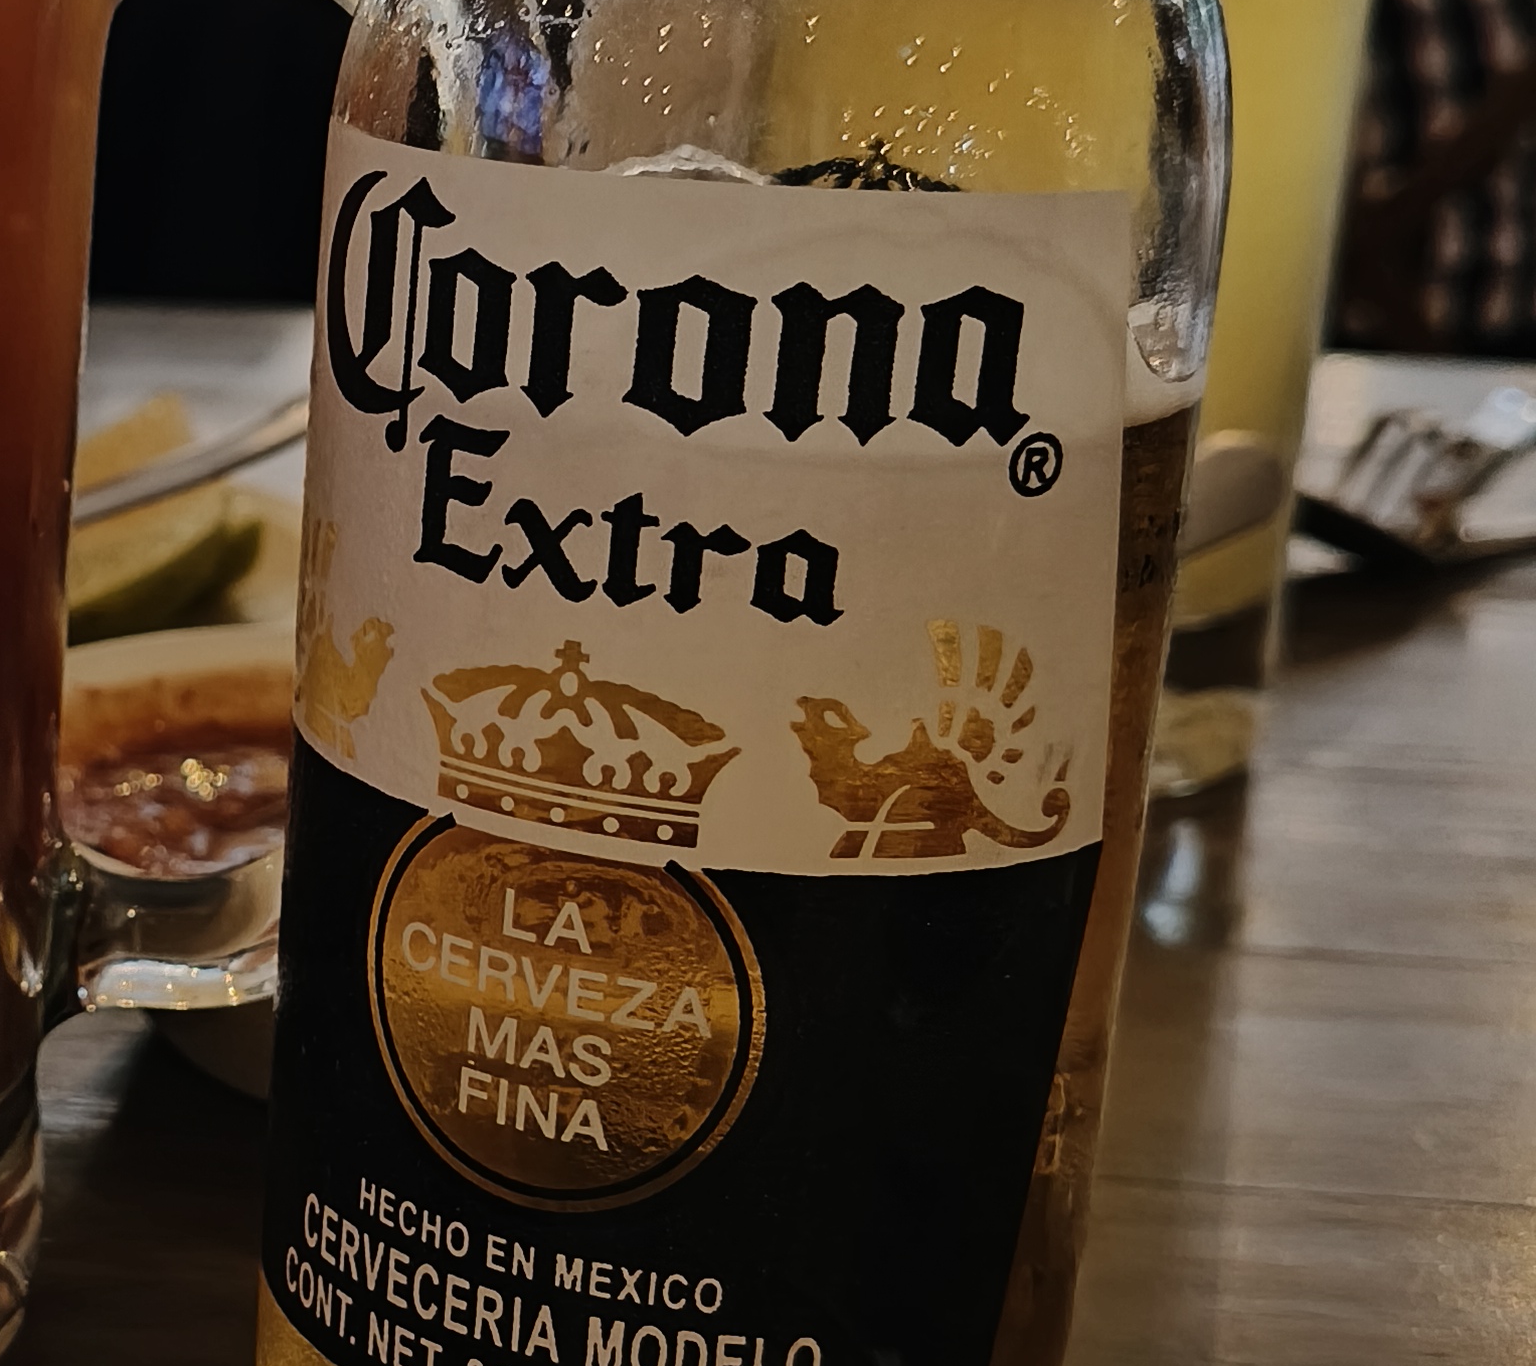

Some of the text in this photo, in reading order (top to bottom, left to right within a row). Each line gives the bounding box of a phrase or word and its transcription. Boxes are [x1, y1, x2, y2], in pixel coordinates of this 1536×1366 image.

[326, 170, 1030, 452] Corona
[413, 414, 845, 627] Extra
[400, 921, 713, 1039] CERVEZA
[502, 888, 593, 954] LA
[465, 1007, 614, 1089] MAS
[458, 1066, 609, 1152] FINA
[285, 1245, 357, 1347] CONT.
[303, 1192, 559, 1365] CERVECERIA
[359, 1177, 724, 1316] HECHO EN MEXICO
